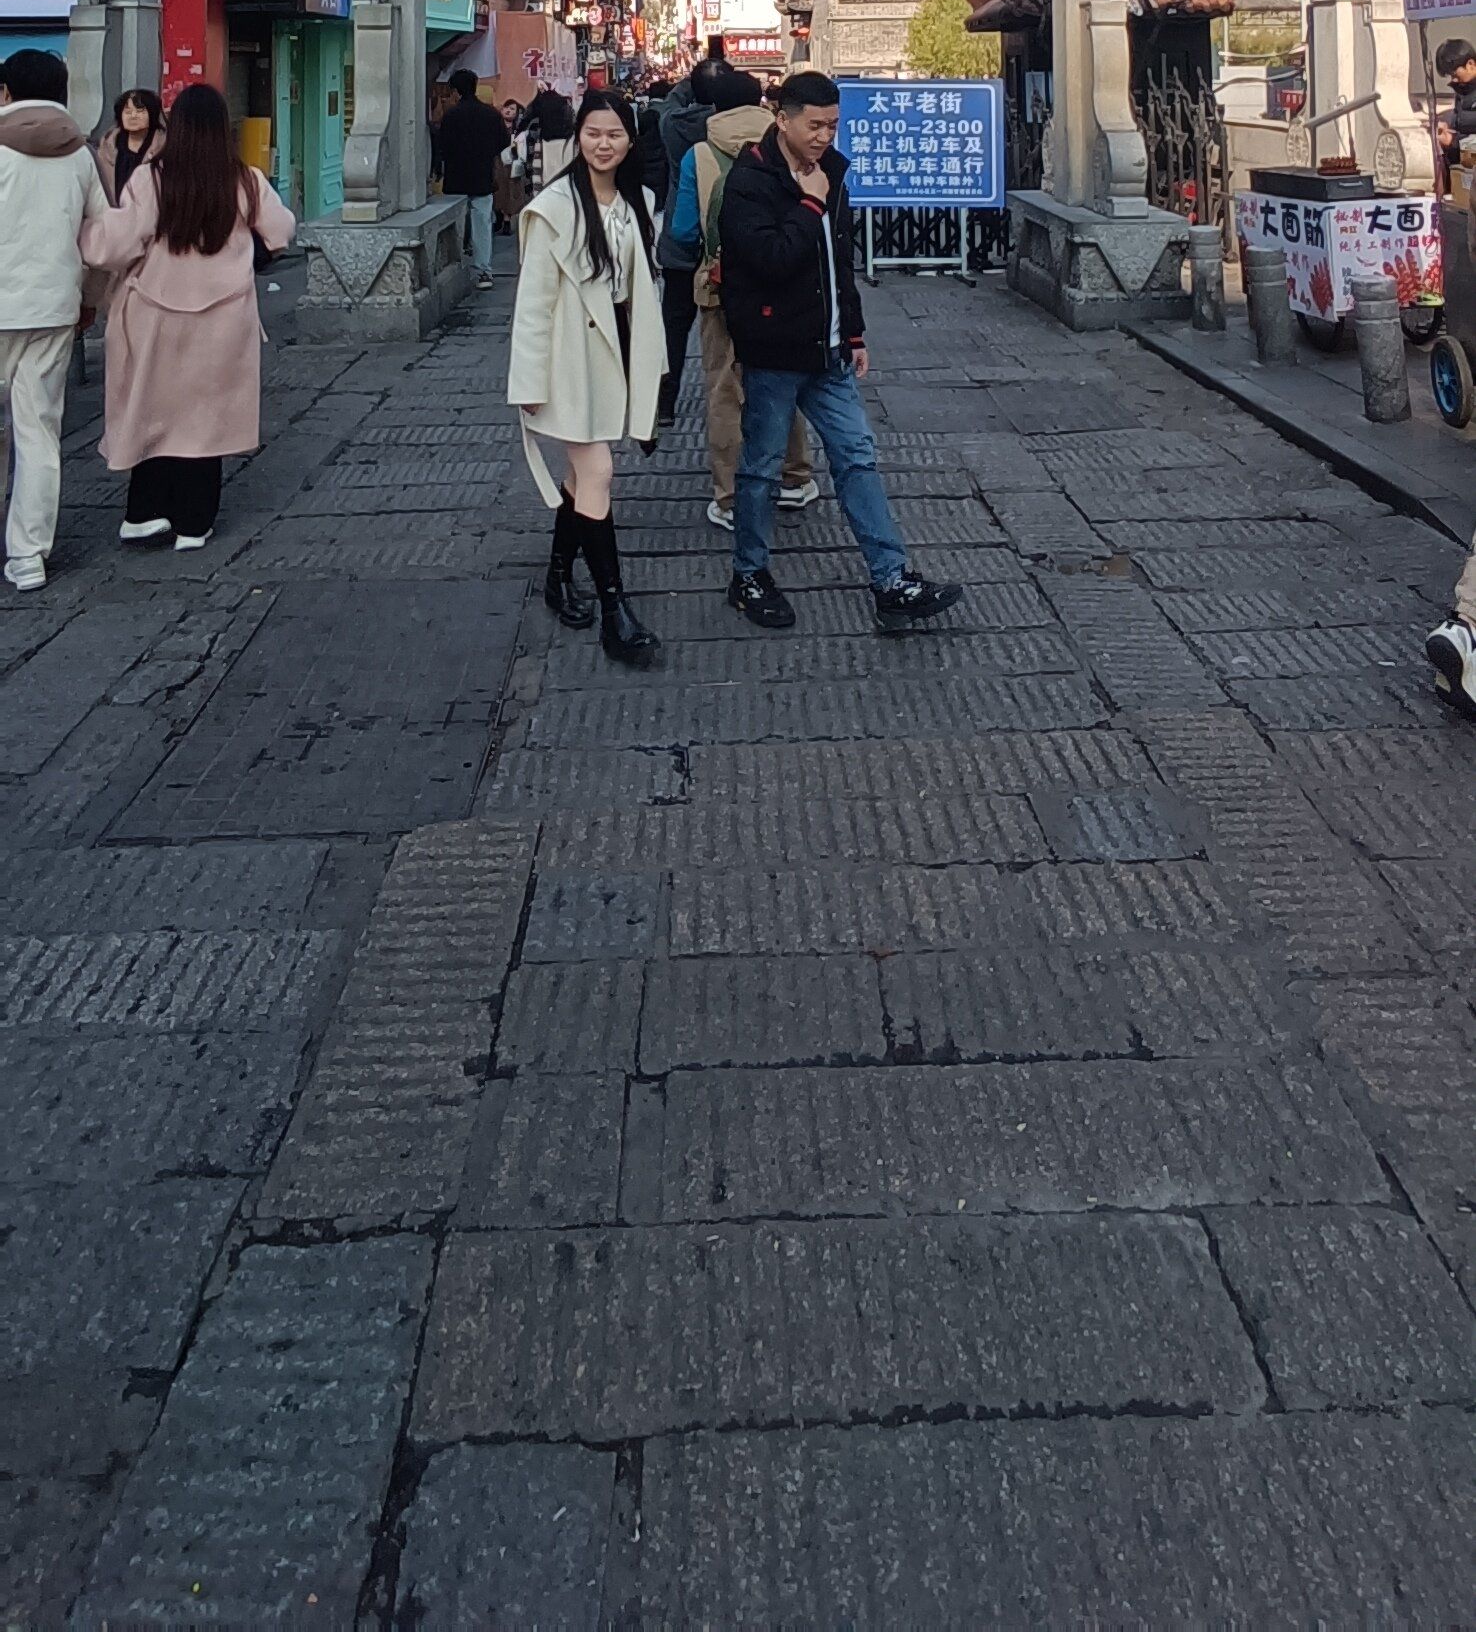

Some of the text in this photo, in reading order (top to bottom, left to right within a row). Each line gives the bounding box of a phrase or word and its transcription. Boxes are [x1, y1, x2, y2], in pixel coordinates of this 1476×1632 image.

[867, 91, 962, 114] 太平老街
[851, 136, 984, 154] 禁止机动车及
[850, 156, 984, 174] 非机动车通行
[1260, 199, 1335, 249] 大面筋
